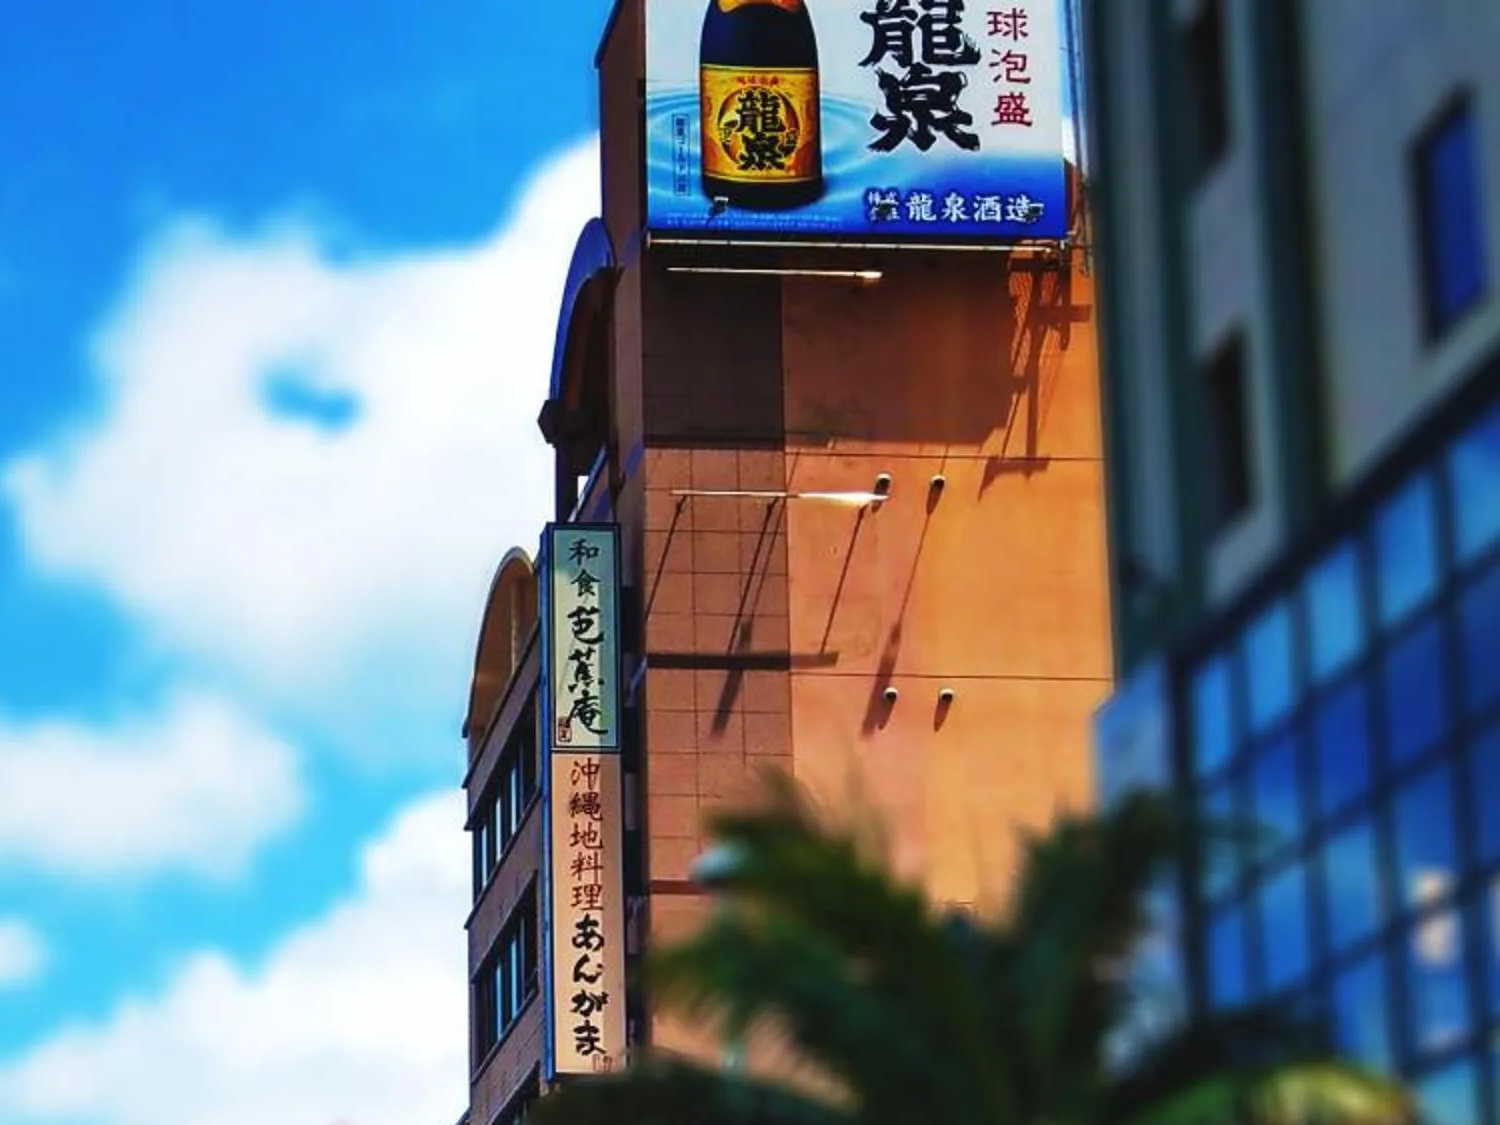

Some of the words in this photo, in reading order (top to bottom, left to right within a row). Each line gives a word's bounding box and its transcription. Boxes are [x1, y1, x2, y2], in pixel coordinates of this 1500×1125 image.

[858, 0, 982, 152] 龍泉
[986, 8, 1033, 127] 球泡盛
[568, 538, 601, 597] 和食
[569, 757, 604, 911] 沖縄地料理
[570, 913, 610, 1057] あんがま
